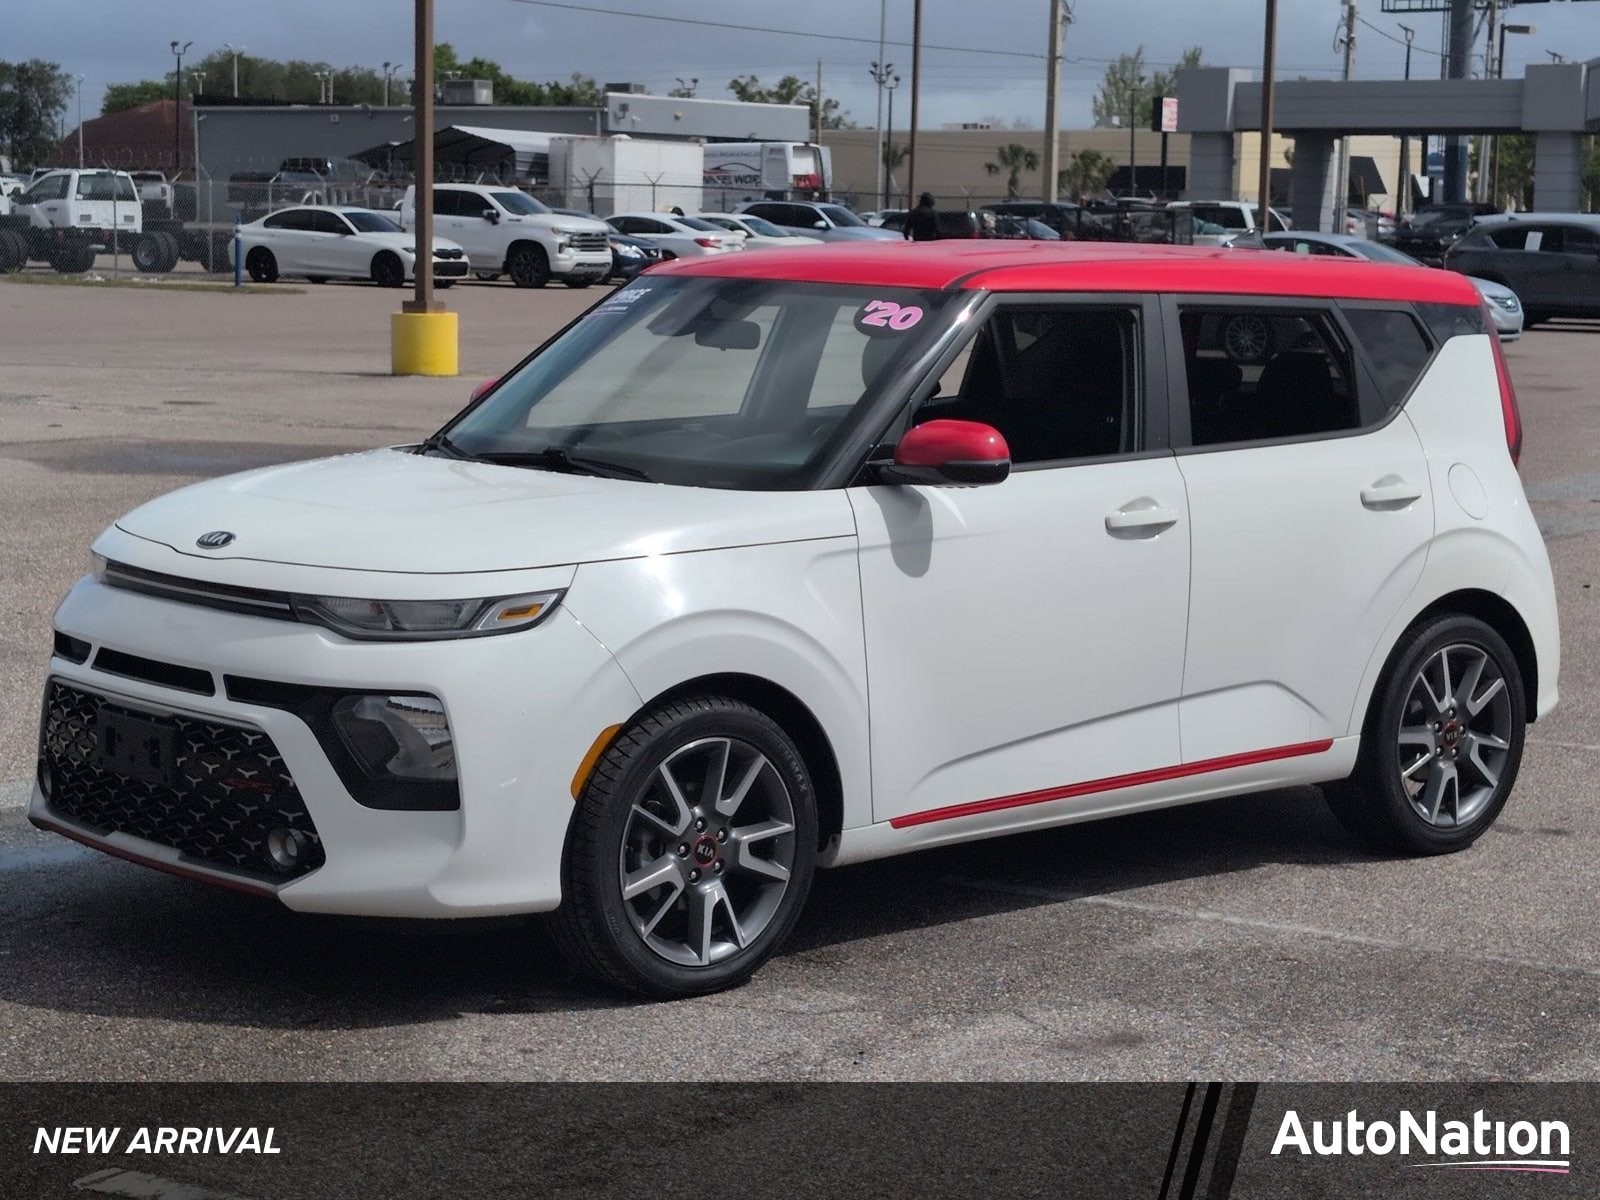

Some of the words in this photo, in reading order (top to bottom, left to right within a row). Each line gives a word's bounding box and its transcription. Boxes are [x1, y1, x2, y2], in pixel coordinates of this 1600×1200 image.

[861, 299, 924, 331] '20
[198, 531, 231, 546] KIA
[696, 843, 714, 859] KIA
